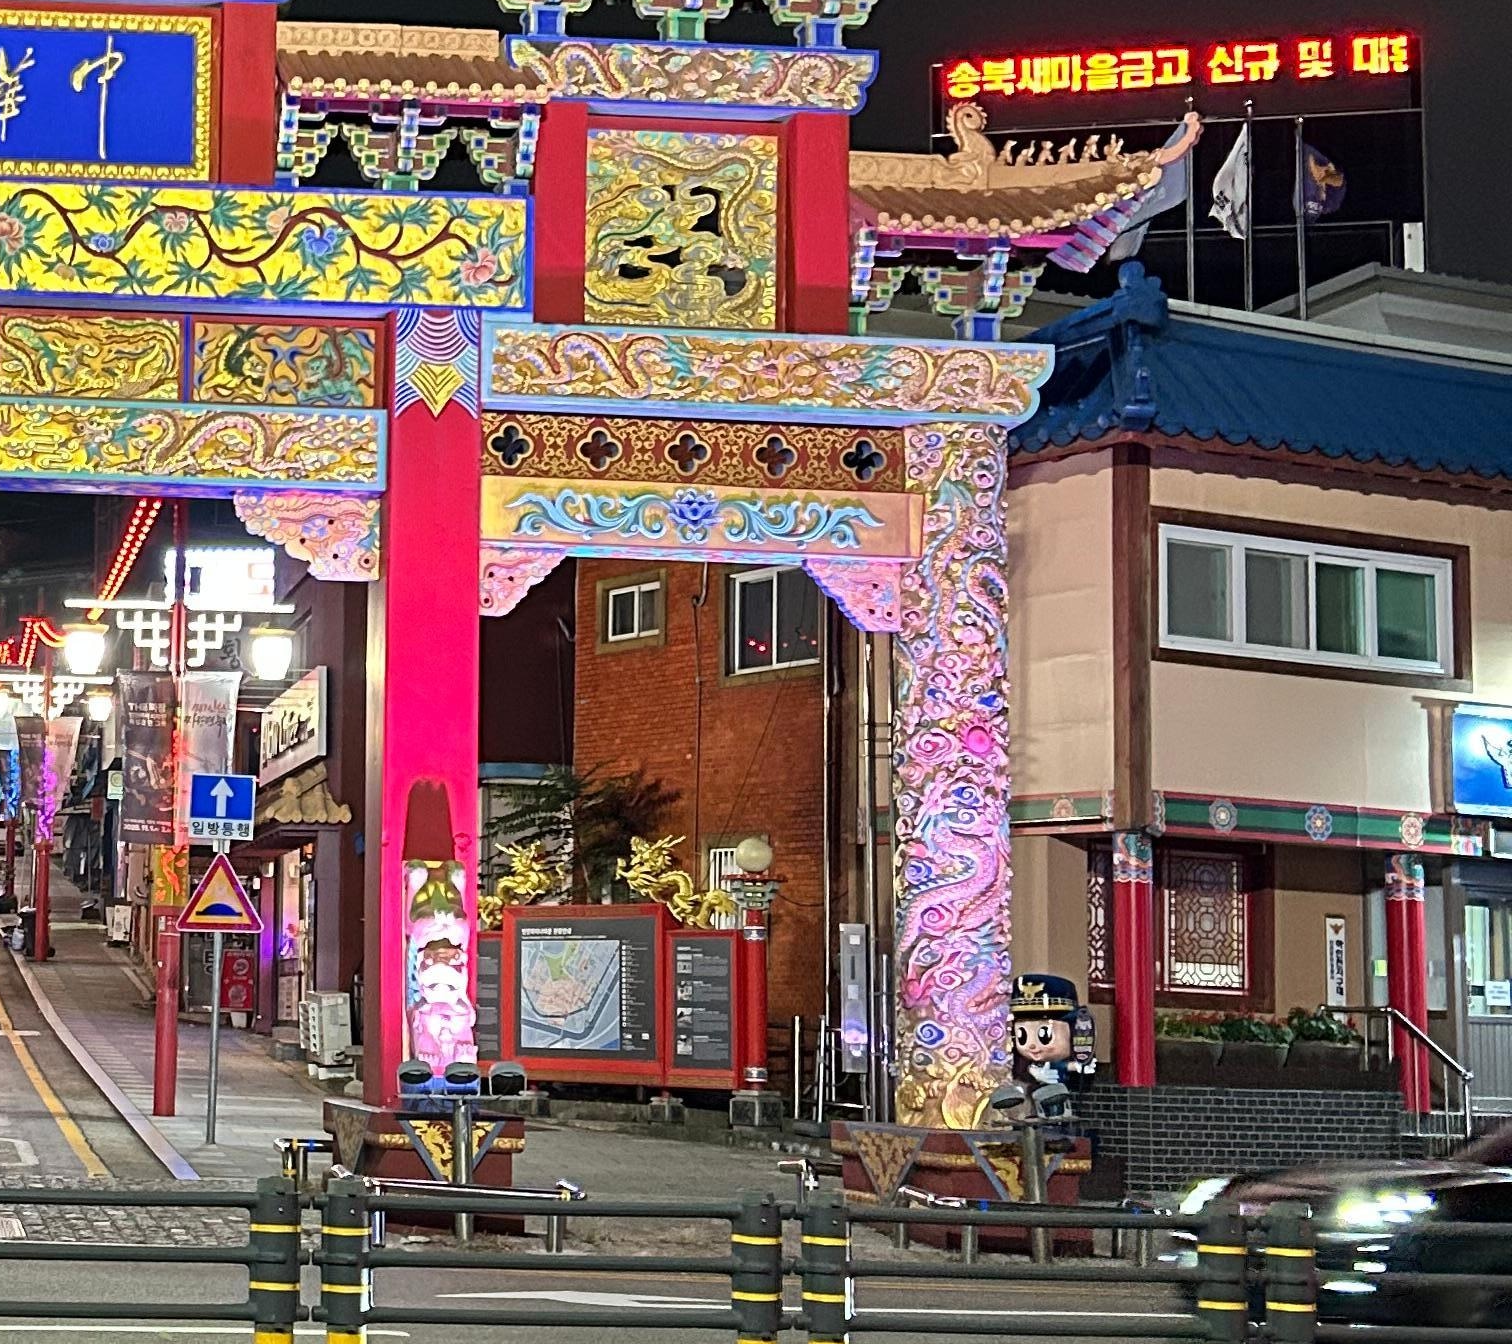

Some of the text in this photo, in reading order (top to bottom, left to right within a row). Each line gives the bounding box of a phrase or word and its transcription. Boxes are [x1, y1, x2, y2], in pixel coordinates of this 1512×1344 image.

[946, 48, 1192, 100] 송북새마을금고
[1207, 43, 1280, 85] 신규
[1297, 37, 1334, 78] 및
[191, 820, 250, 838] 일방통행
